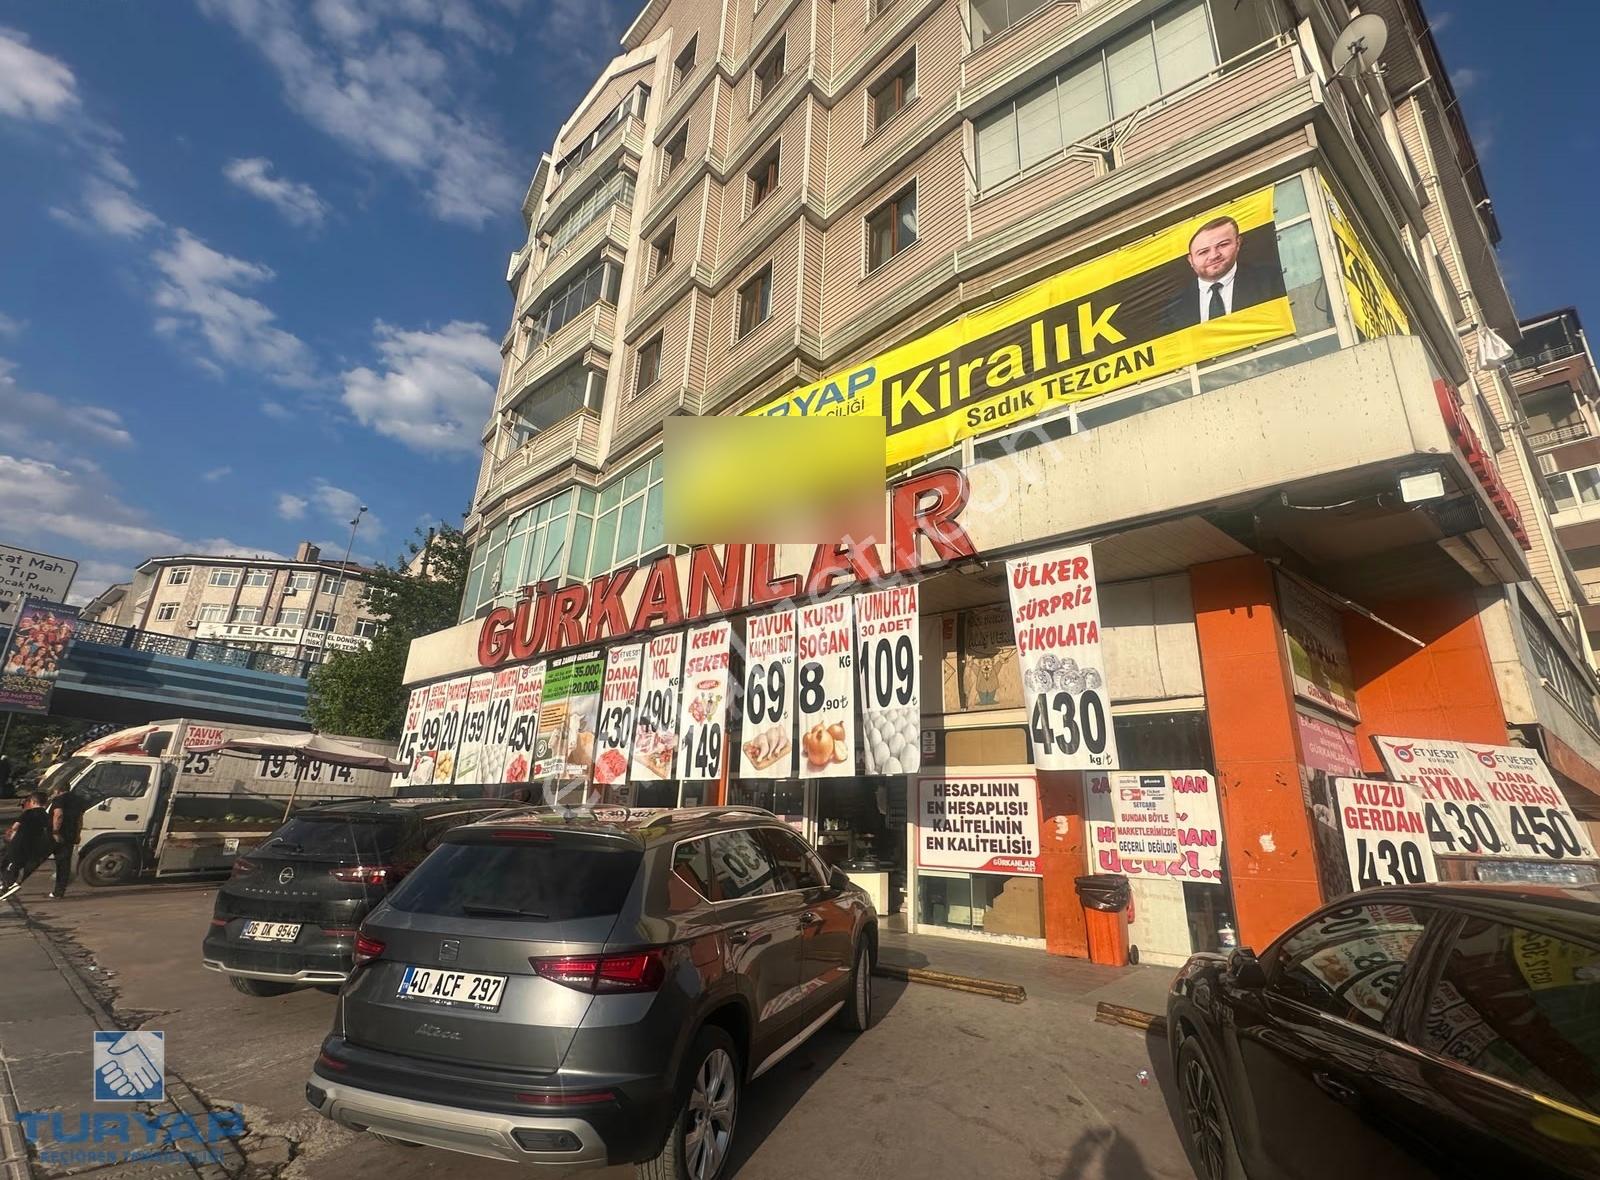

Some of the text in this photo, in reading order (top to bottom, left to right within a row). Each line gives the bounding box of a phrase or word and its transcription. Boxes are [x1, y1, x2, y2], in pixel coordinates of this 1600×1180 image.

[891, 302, 1128, 427] Kiralık
[967, 346, 1156, 428] Sadık TEZCAN
[1013, 556, 1089, 589] ÜLKER
[803, 602, 844, 629] KURU
[855, 586, 917, 623] YUMURTA
[1016, 585, 1093, 624] SÜRPRİZ
[749, 612, 793, 638] TAVUK
[861, 618, 912, 637] 30 ADET
[649, 636, 678, 658] KUZU
[691, 628, 728, 650] KENT
[778, 635, 793, 653] BUT
[800, 627, 849, 660] SOĞAN
[1018, 621, 1099, 657] ÇİKOLATA
[652, 658, 670, 680] KOL
[686, 652, 730, 678] ŞEKER
[781, 657, 792, 665] KG
[839, 655, 851, 669] KG
[607, 665, 638, 681] DANA
[669, 677, 679, 687] KG
[518, 679, 542, 694] DANA
[604, 682, 637, 702] KIYMA
[406, 712, 419, 731] SU
[440, 711, 459, 750] 20
[463, 710, 485, 743] 159
[485, 698, 510, 745] 119
[600, 706, 632, 748] 430
[1031, 690, 1107, 755] 430
[189, 728, 223, 740] TAVUK
[419, 717, 440, 750] 99
[509, 715, 536, 752] 450
[683, 722, 721, 778] 149
[1419, 767, 1452, 776] DANA
[1494, 771, 1537, 785] DANA
[934, 783, 1019, 797] HESAPLININ
[1353, 783, 1404, 807] KUZU
[1488, 782, 1561, 810] KUŞBAŞI
[927, 801, 1028, 816] EN HESAPLISI!
[1121, 812, 1169, 823] BUNDAN BÖYLE
[933, 816, 1022, 834] KALİTELİNİN
[1117, 826, 1176, 837] MARKETLERİMİZDE
[1344, 807, 1425, 834] GERDAN
[926, 834, 1032, 855] EN KALİTELİSİ!
[1119, 841, 1178, 854] GEÇERLİ DEĞİLDİR
[993, 858, 1035, 867] GÜRKANLAR
[1357, 838, 1427, 888] 439
[247, 921, 259, 935] 06
[275, 924, 299, 938] 9549
[410, 970, 501, 1002] 40 ACF 297
